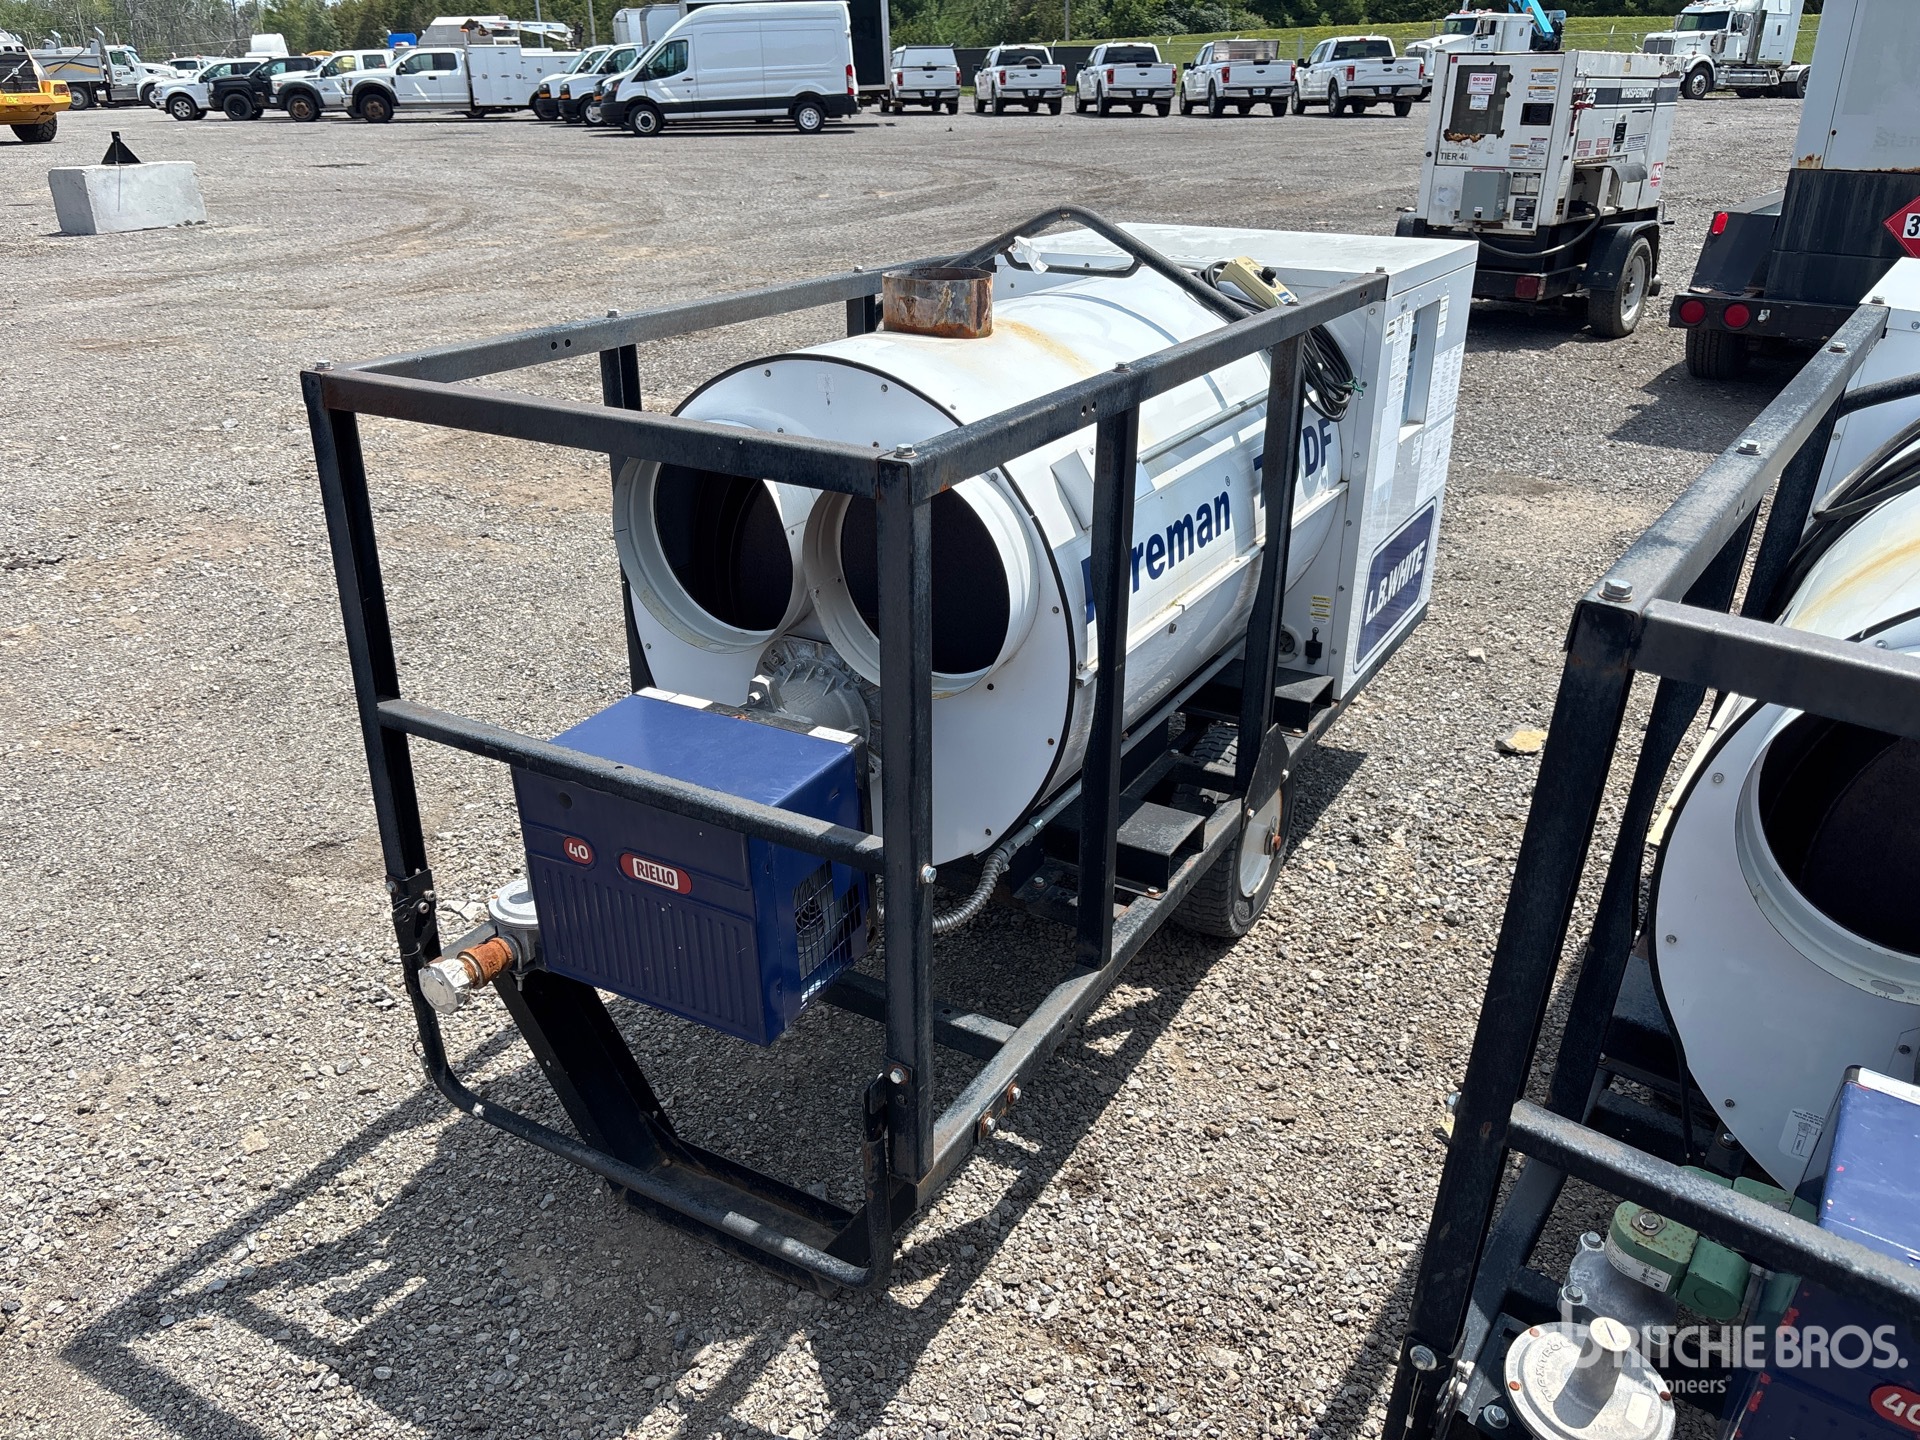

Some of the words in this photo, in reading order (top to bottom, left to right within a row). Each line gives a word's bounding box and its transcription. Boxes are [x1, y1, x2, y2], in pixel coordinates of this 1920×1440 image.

[1440, 152, 1458, 161] TIER
[1081, 491, 1230, 625] reman
[568, 842, 589, 860] 40
[636, 860, 675, 886] RIELLO
